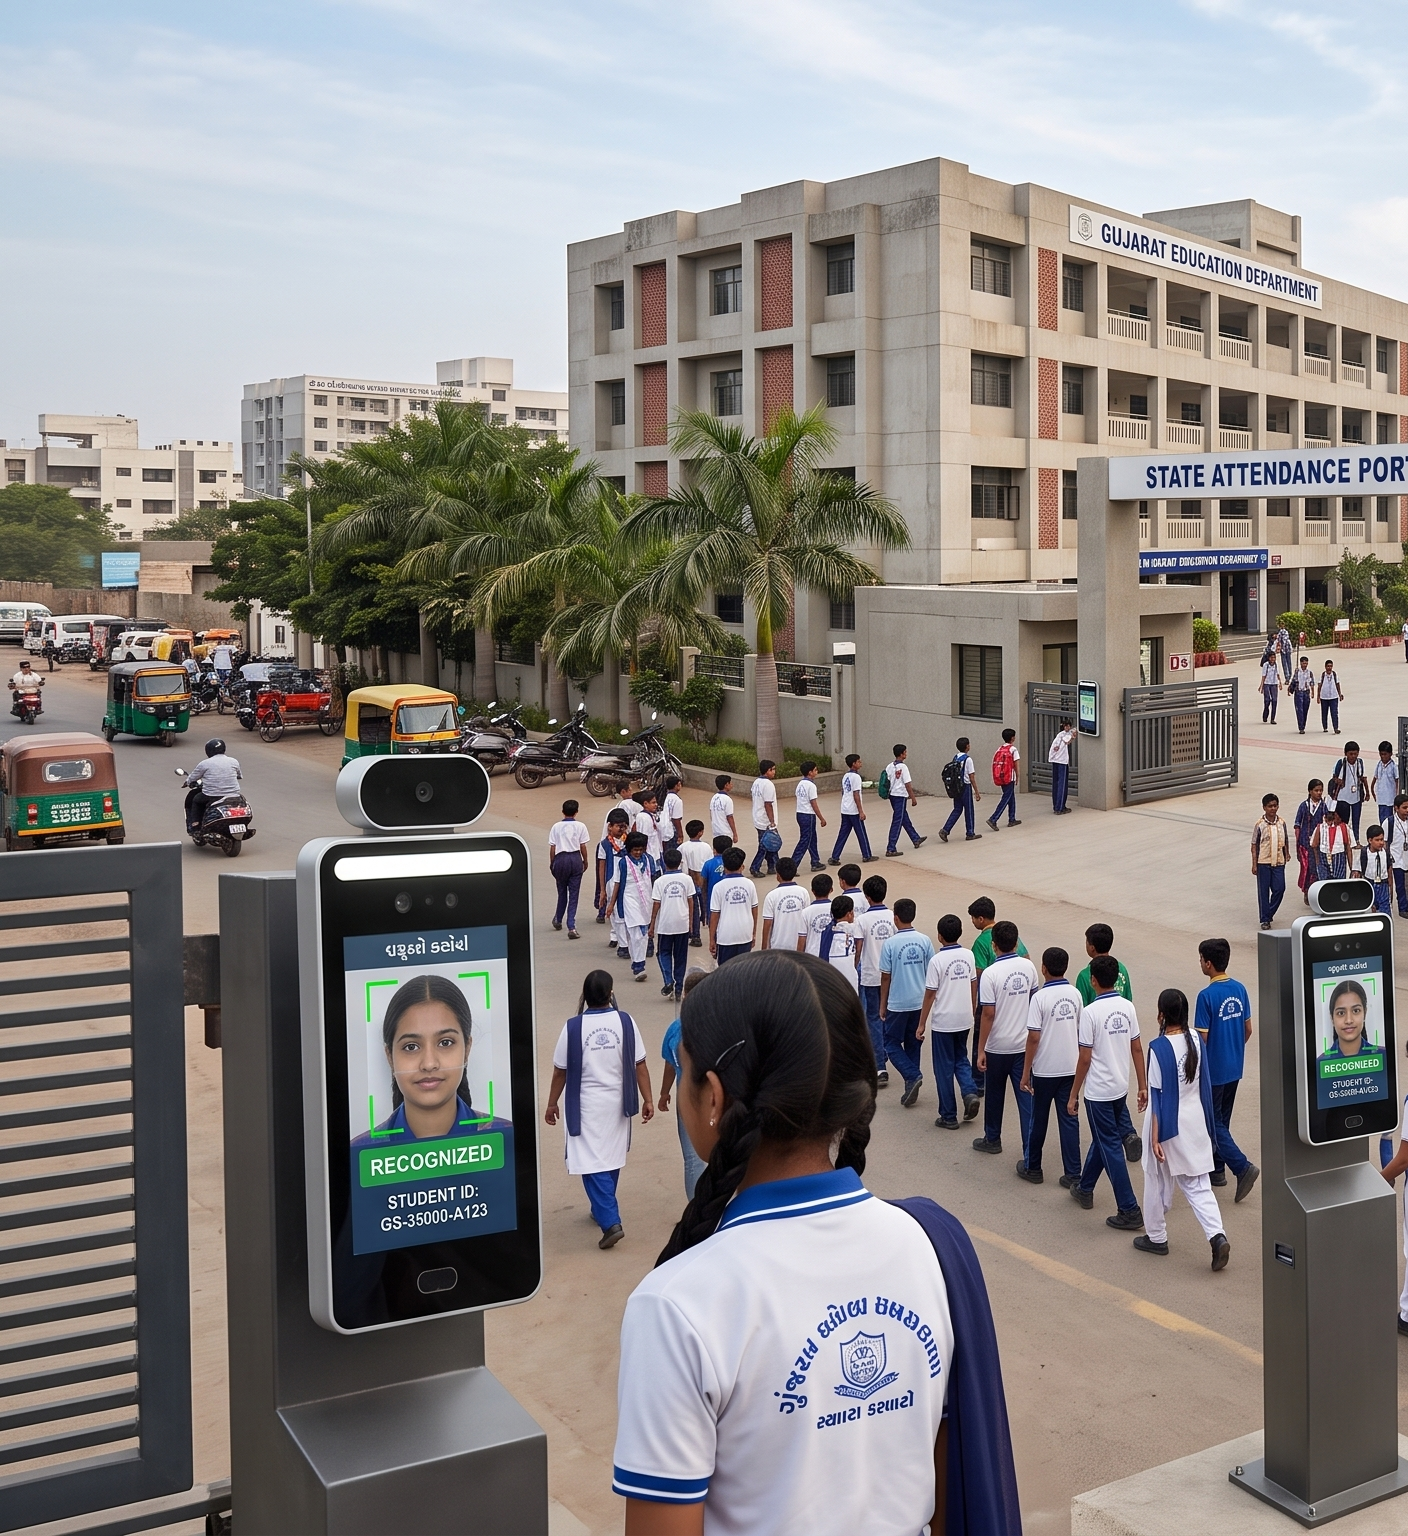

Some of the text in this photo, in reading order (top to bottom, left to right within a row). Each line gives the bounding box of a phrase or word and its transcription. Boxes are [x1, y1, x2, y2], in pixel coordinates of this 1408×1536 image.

[1101, 223, 1319, 302] GUJARAT EDUCATION DEPARTMENT
[1146, 464, 1205, 489] STATE
[1211, 458, 1350, 487] ATTENDANCE
[370, 1144, 493, 1177] RECOGNIZED
[388, 1184, 479, 1210] STUDENT ID:
[381, 1203, 488, 1232] GS-35000-A123
